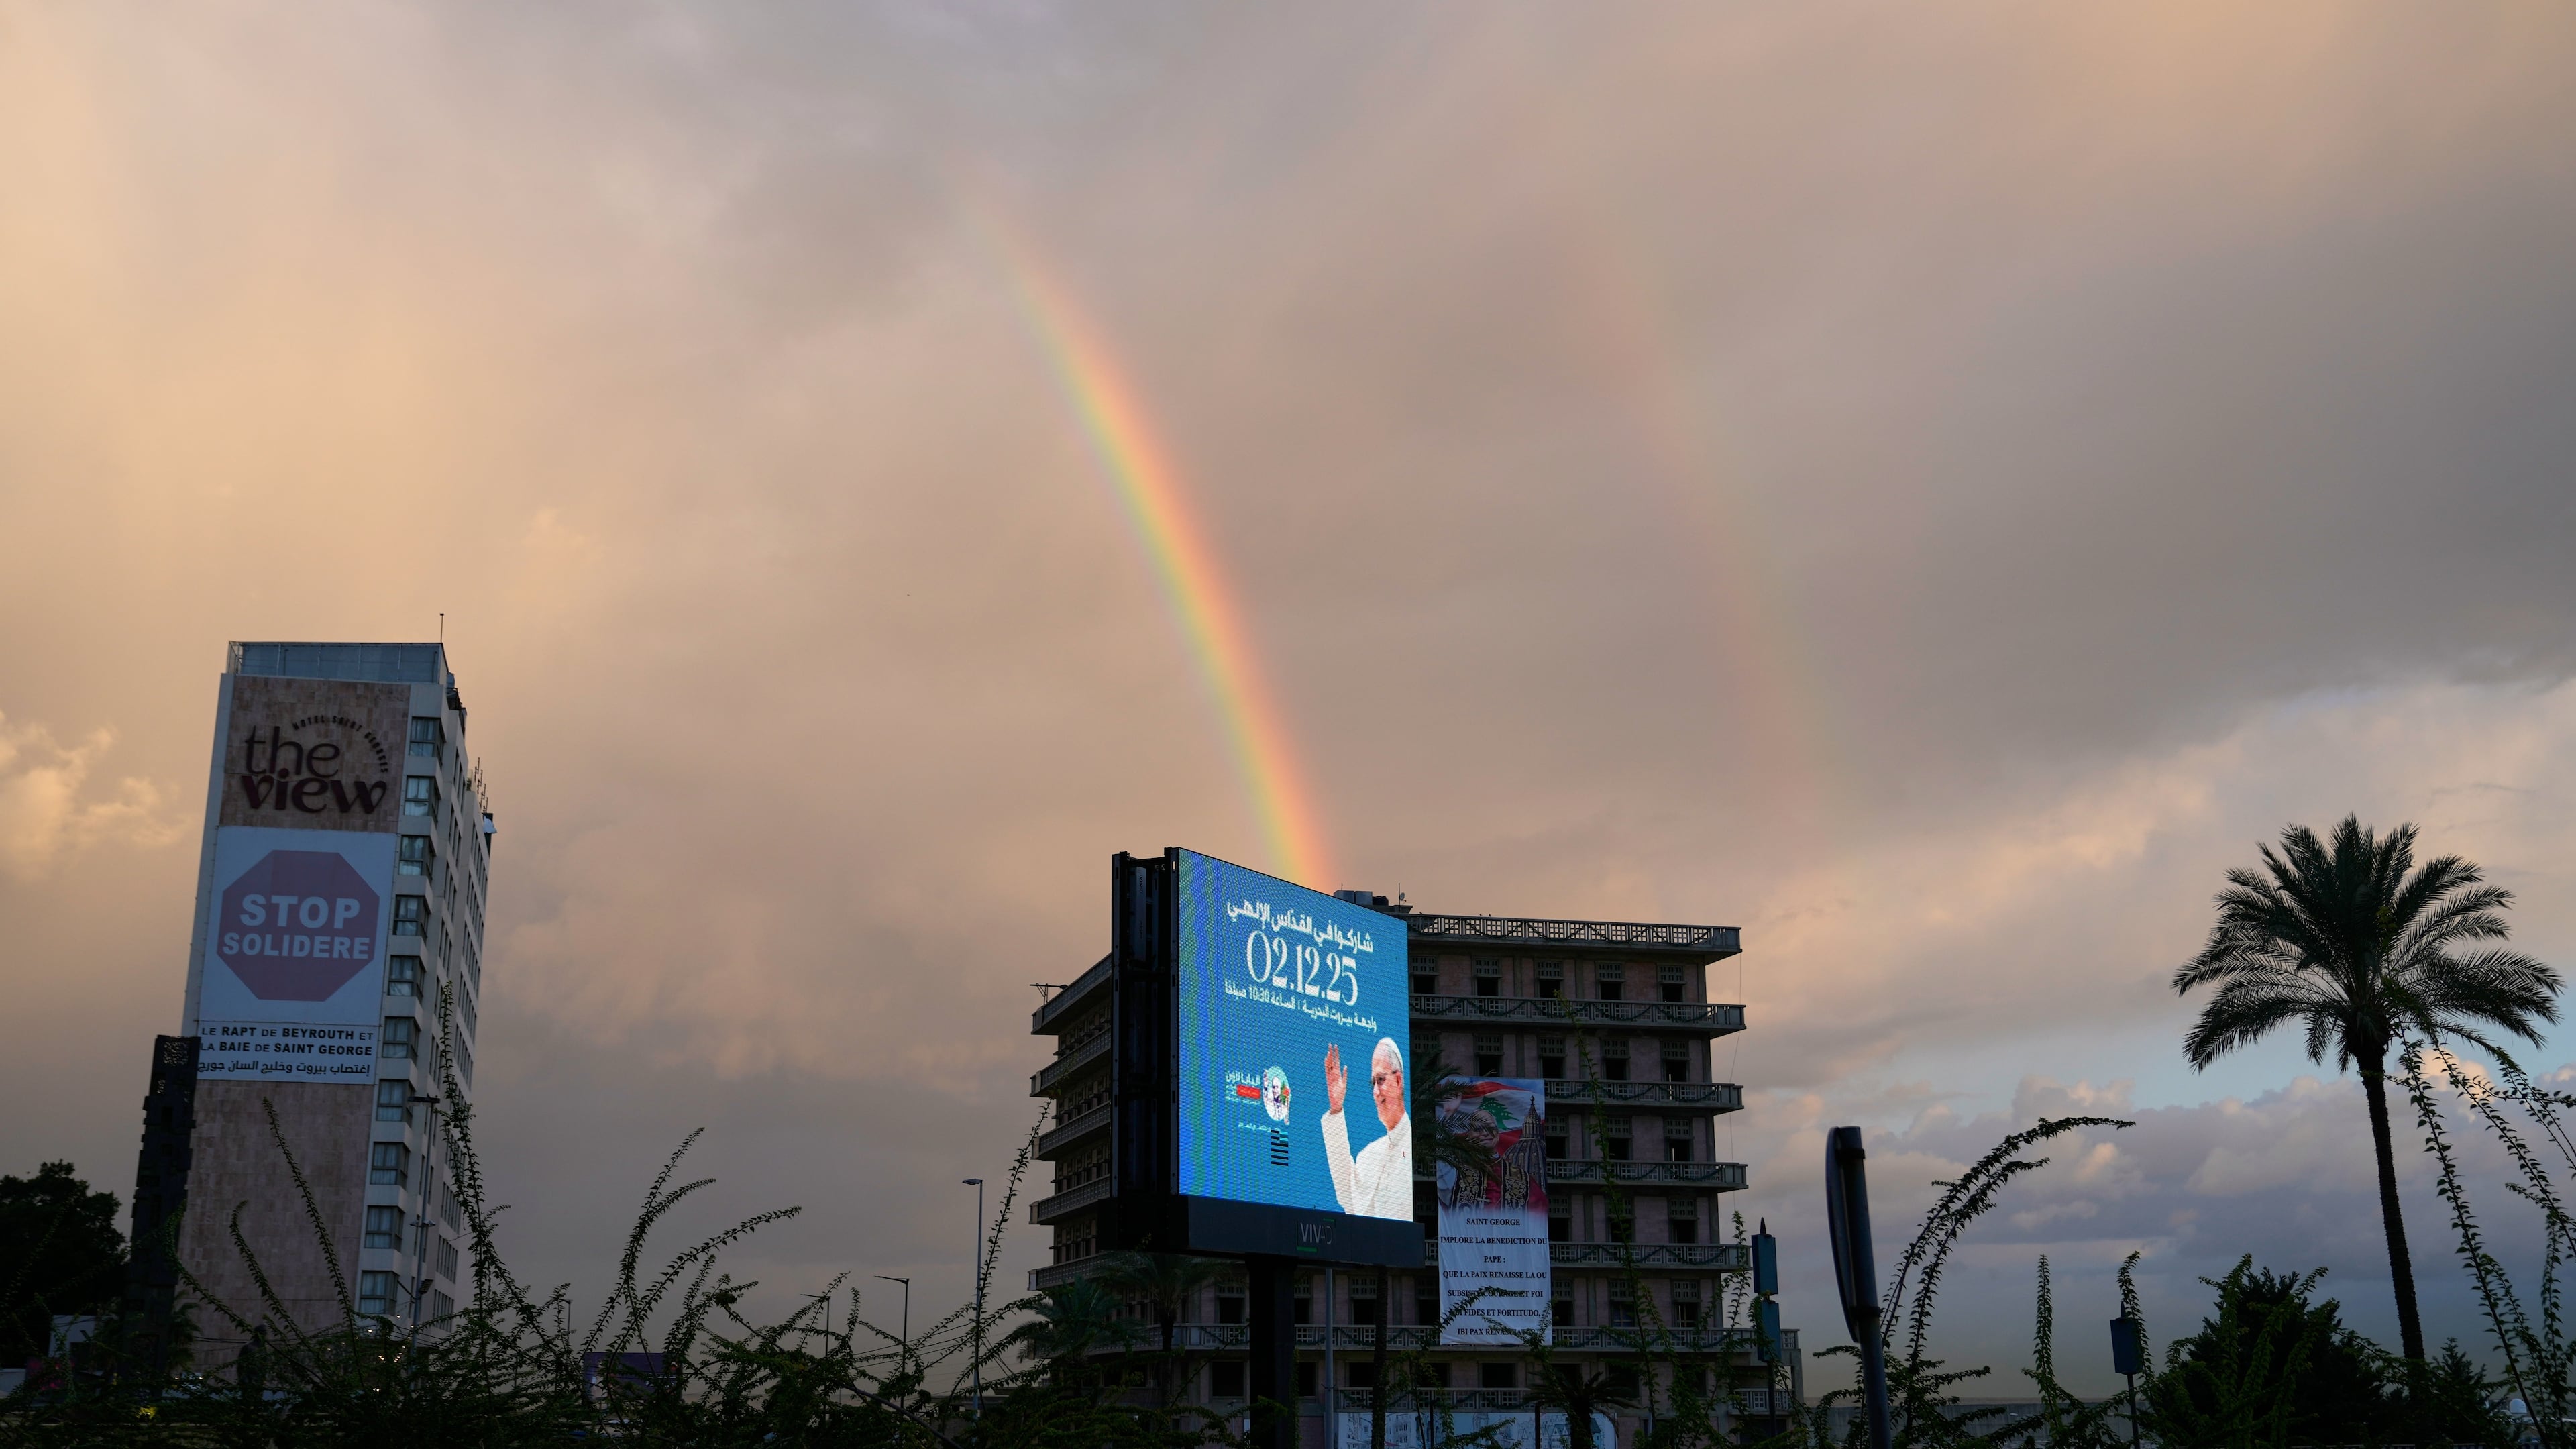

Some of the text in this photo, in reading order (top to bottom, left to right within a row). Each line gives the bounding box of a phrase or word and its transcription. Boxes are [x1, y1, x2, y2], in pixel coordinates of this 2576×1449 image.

[245, 725, 340, 778] the
[292, 715, 388, 773] HOTEL SAINT GEORGES
[241, 768, 387, 814] view
[239, 894, 361, 930] STOP
[1313, 920, 1334, 948] في
[1334, 924, 1374, 954] شاركوا
[222, 932, 370, 960] SOLIDERE
[1246, 930, 1358, 1006] 02.12.25
[1248, 985, 1270, 1003] 10:30
[1271, 993, 1295, 1010] الساعة
[1302, 1000, 1330, 1021] البحرية
[1330, 1008, 1354, 1027] بيروت
[202, 1028, 217, 1036] LE
[222, 1026, 256, 1036] RAPT
[282, 1028, 354, 1040] BEYROUTH
[359, 1032, 374, 1040] ET
[200, 1042, 372, 1055] LA BAIE DE SAINT GEORGE
[197, 1061, 225, 1073] جورج
[227, 1059, 258, 1073] السان
[260, 1061, 293, 1074] وخليج
[296, 1062, 327, 1075] بيروت
[1443, 1271, 1458, 1279] QUE
